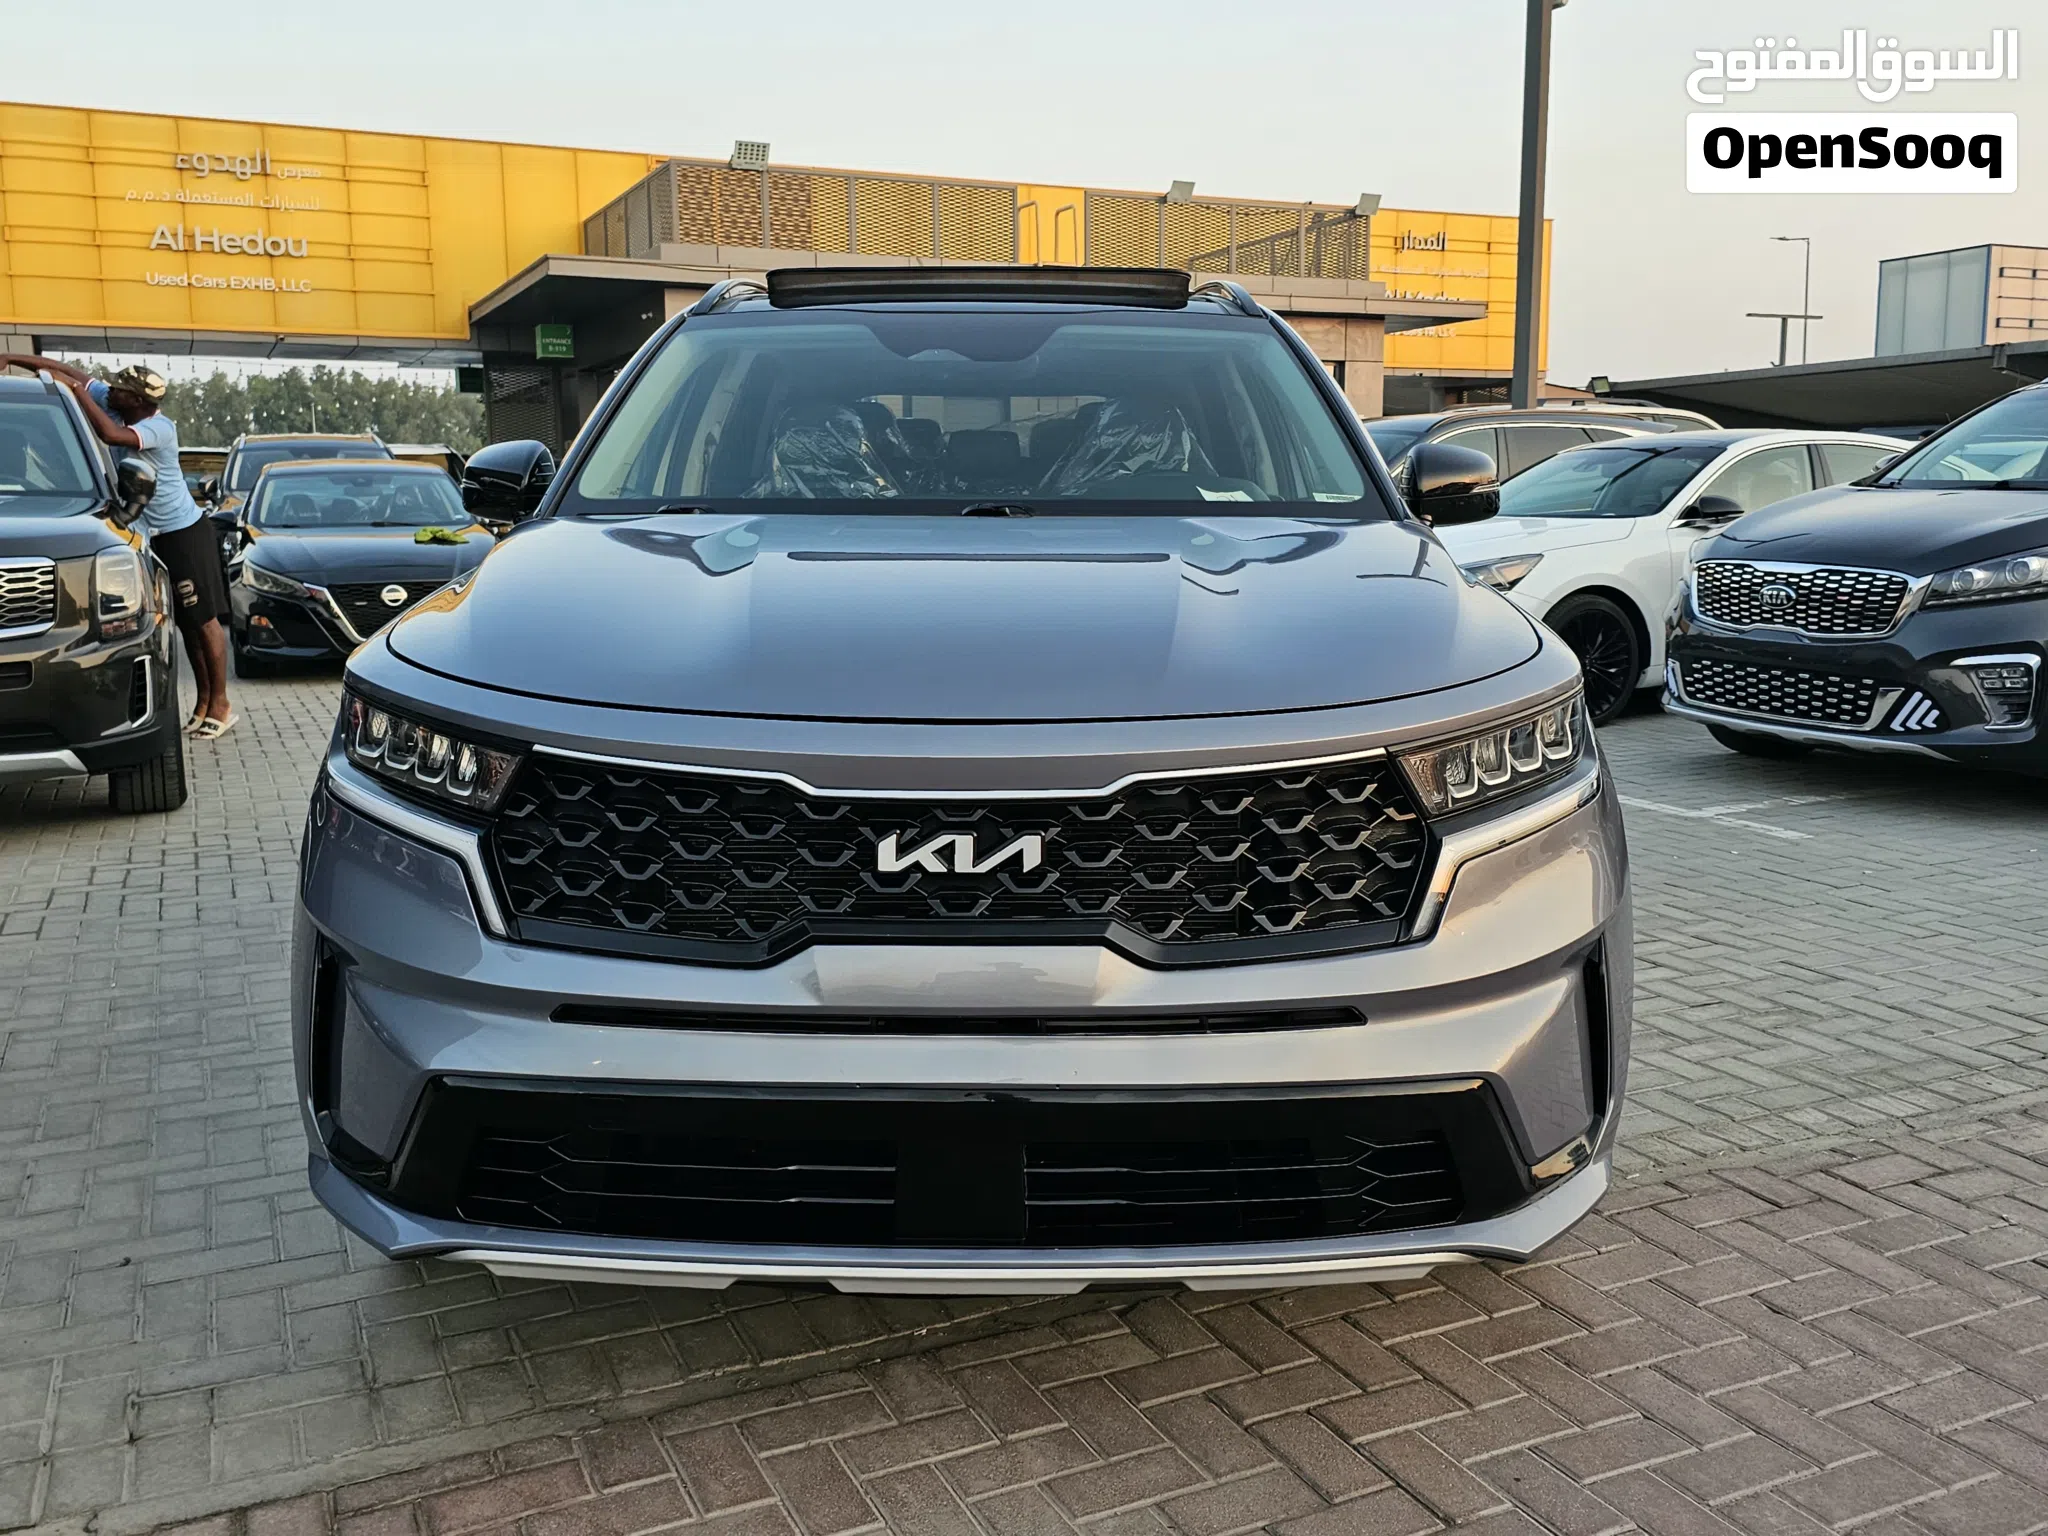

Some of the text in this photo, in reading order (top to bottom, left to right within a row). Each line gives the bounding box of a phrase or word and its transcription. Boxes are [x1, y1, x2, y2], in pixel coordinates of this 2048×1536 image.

[176, 148, 321, 180] معرض الهدوء
[175, 189, 254, 207] المستعملة
[150, 224, 308, 257] Al Hedou
[1401, 231, 1447, 252] المدار
[146, 272, 188, 287] Used
[191, 274, 227, 288] Cars
[282, 278, 312, 292] LLC
[1762, 590, 1788, 604] KIA
